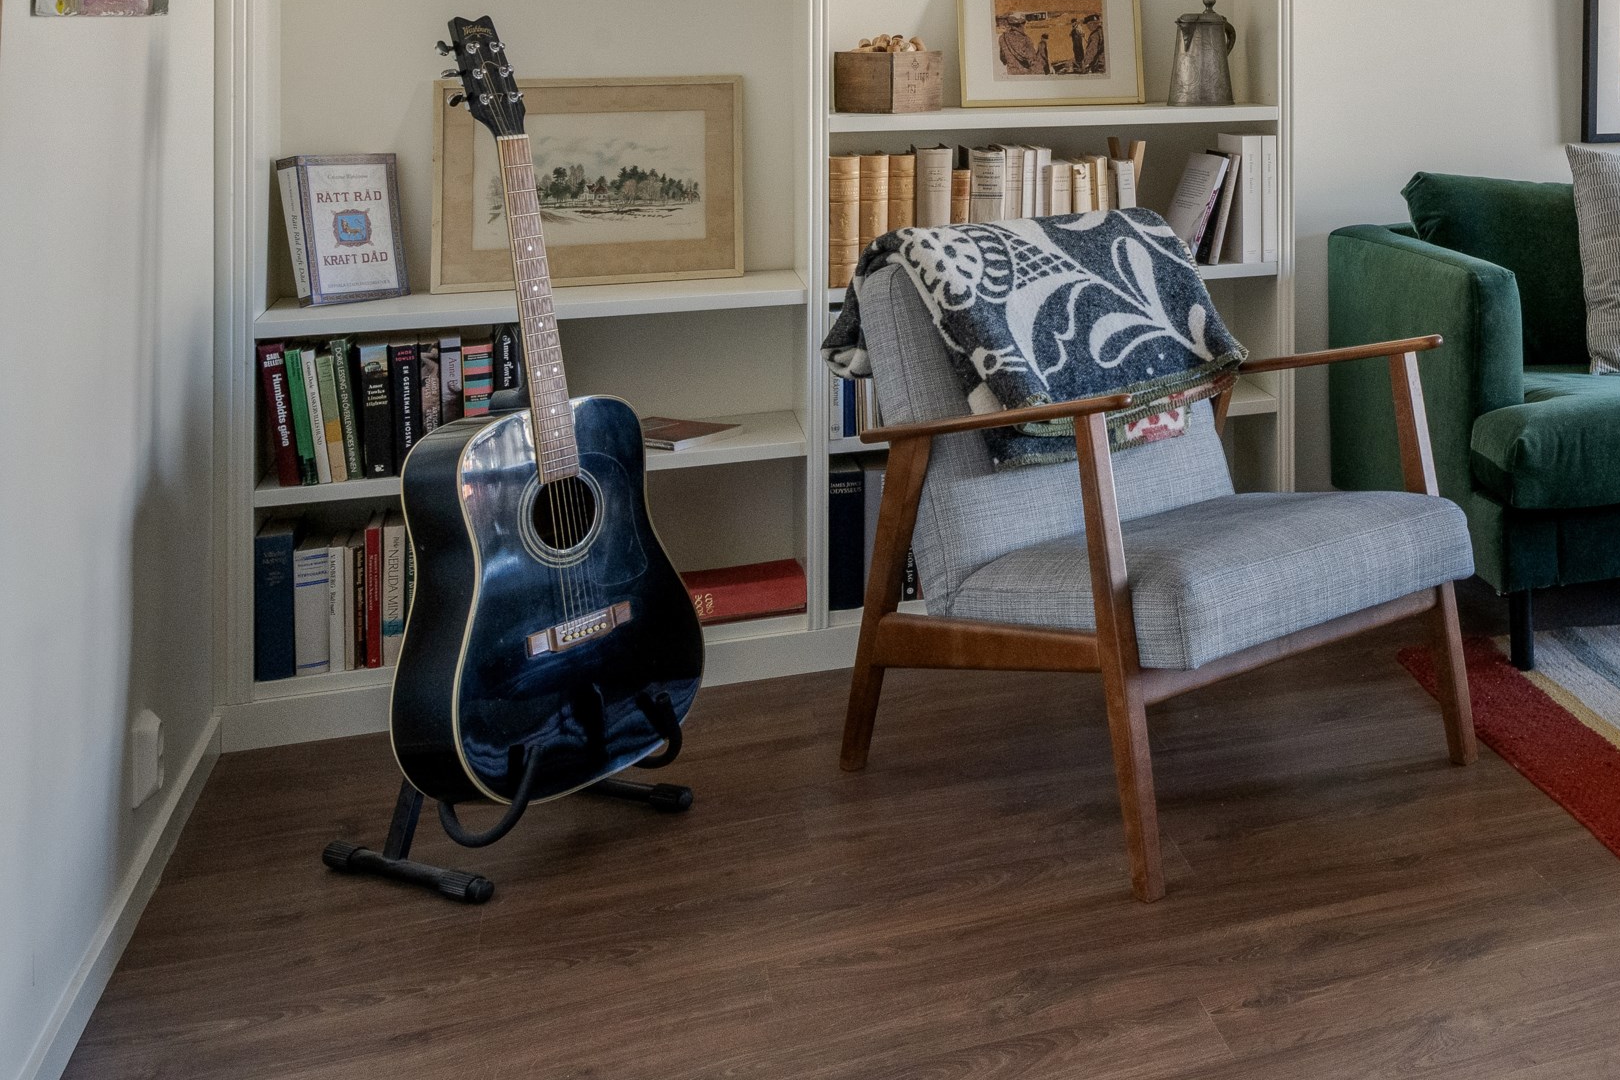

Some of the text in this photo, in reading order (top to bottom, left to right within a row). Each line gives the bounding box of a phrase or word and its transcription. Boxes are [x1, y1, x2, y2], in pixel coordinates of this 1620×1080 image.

[354, 189, 382, 202] RÅD
[323, 250, 388, 266] KRAFT DÅD
[403, 366, 409, 374] EN
[448, 357, 456, 377] Anne
[502, 335, 513, 387] Amor Towles
[272, 374, 290, 447] Humboldts gåva
[335, 347, 356, 473] DORIS LESSING EN ÖVERLEVANDES MINNEN
[388, 550, 399, 638] NERUDA MINNEN
